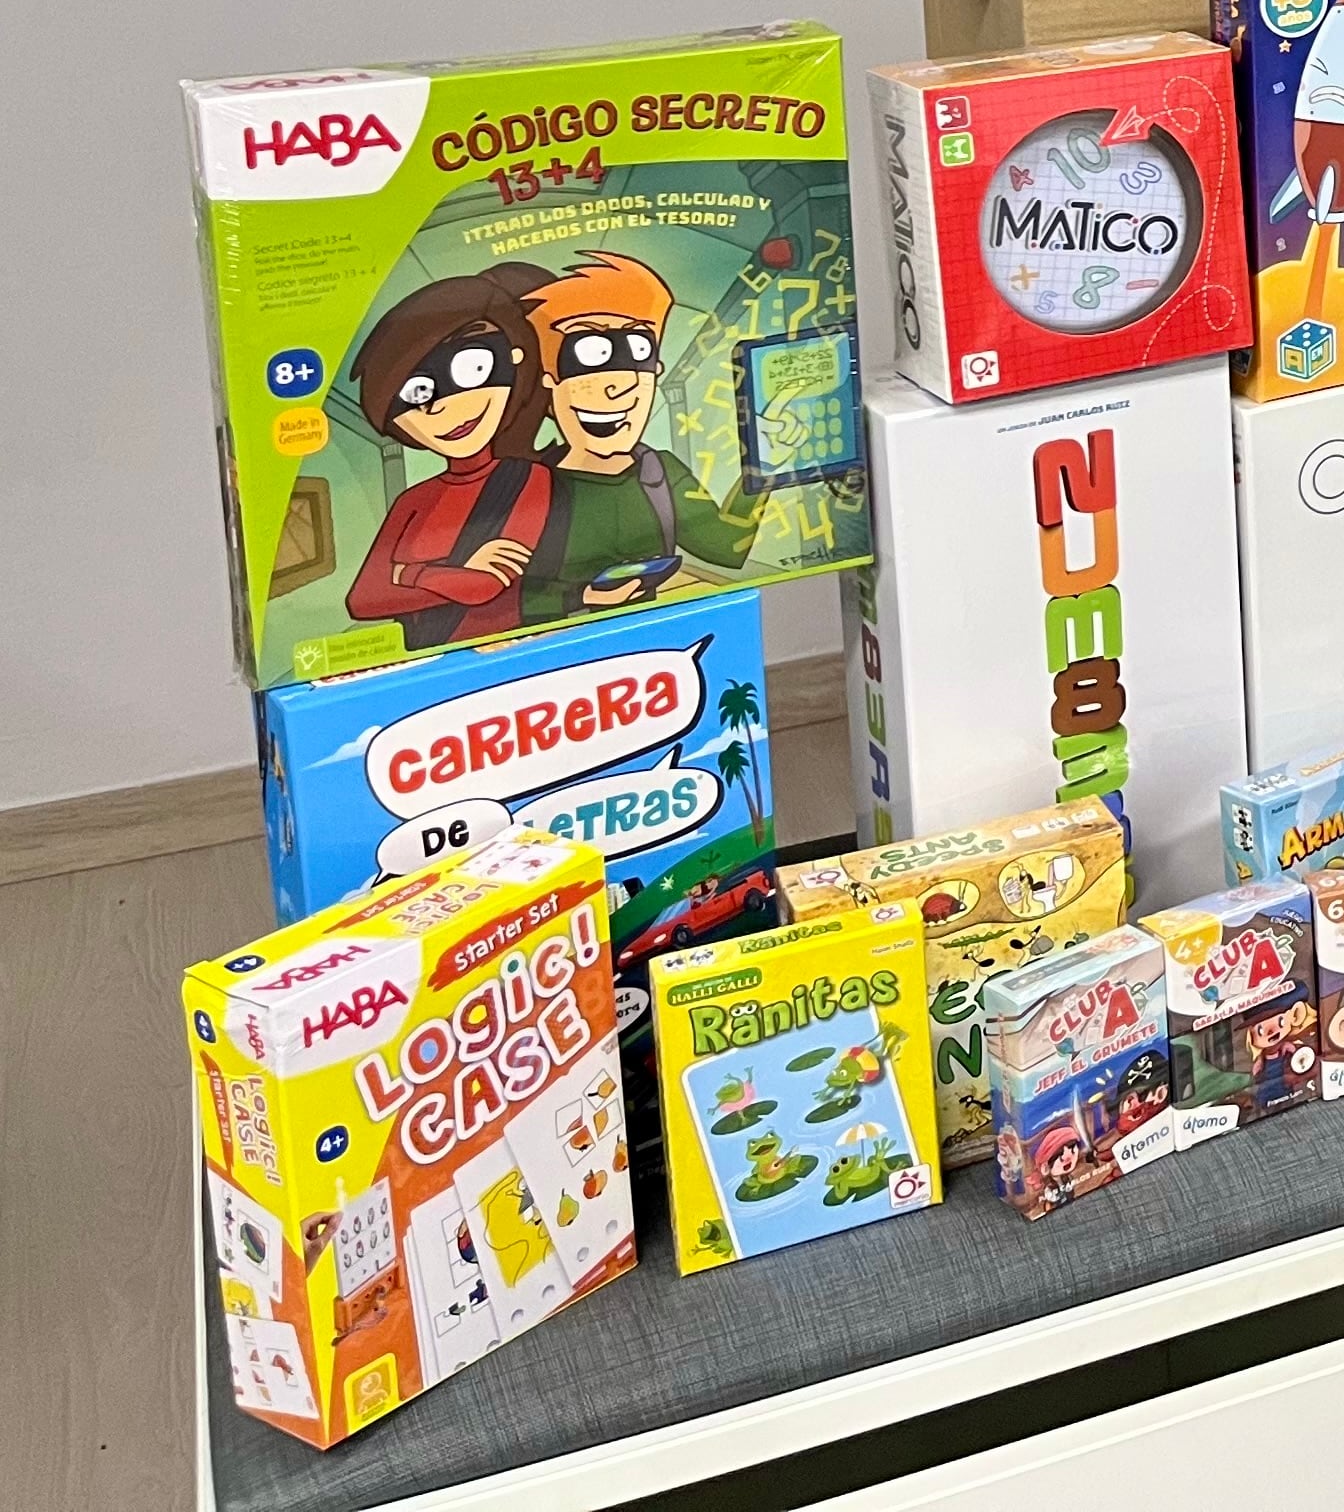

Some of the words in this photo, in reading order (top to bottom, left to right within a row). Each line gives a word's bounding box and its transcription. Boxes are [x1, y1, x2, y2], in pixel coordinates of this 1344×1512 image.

[244, 114, 401, 169] HABA
[631, 93, 826, 138] SECRETO
[488, 146, 606, 205] 13+4
[491, 227, 582, 256] HACEROS
[586, 217, 624, 234] CON
[628, 214, 651, 228] EL
[655, 212, 736, 228] TESORO!
[539, 204, 577, 223] LOS
[656, 192, 755, 210] CALCULAD
[759, 197, 772, 211] Y
[279, 430, 323, 445] Germany
[455, 922, 524, 971] Starter
[530, 893, 560, 923] Set
[1193, 929, 1257, 991] CLUB
[1247, 939, 1285, 990] A
[303, 979, 409, 1049] HABA
[356, 904, 599, 1122] Logic!
[671, 984, 712, 1004] HALLI
[716, 975, 759, 996] GALLI
[1048, 979, 1114, 1045] CLUB
[1102, 984, 1141, 1039] A
[402, 989, 590, 1164] CASE
[1034, 1068, 1068, 1096] JEFF
[1070, 1060, 1088, 1076] EL
[1091, 1021, 1159, 1064] GRUMETE
